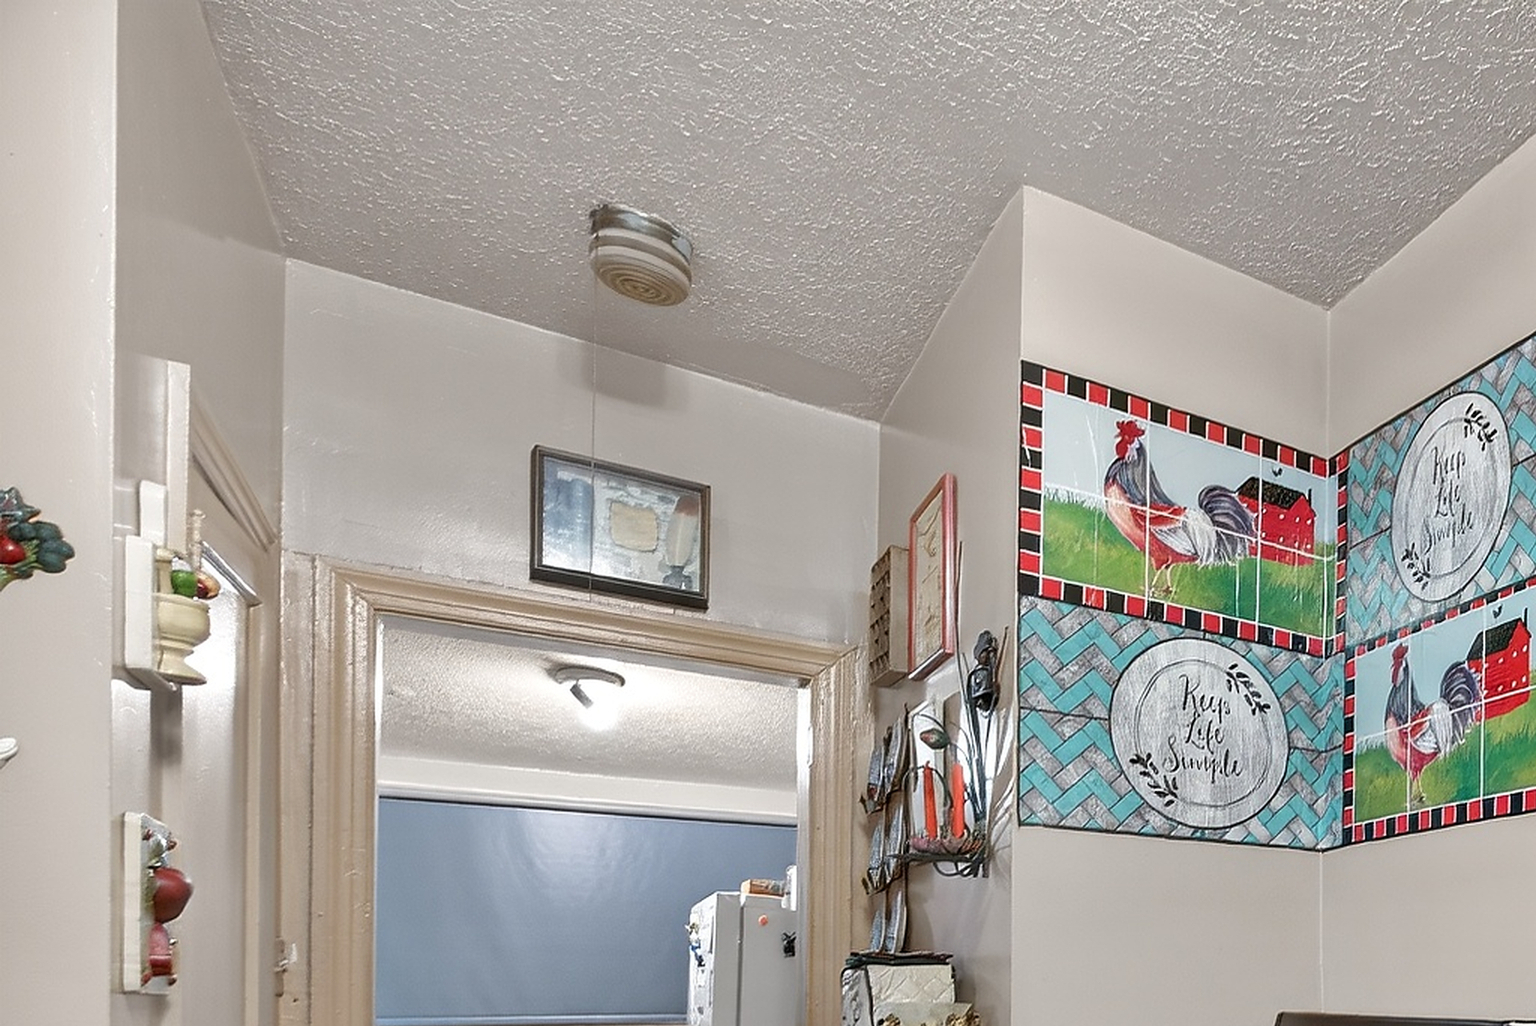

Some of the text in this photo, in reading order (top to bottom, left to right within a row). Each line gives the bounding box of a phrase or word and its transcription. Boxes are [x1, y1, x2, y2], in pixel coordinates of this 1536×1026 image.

[1431, 445, 1466, 485] Keep
[1434, 479, 1461, 518] Life
[1421, 502, 1474, 556] Simple
[1178, 674, 1231, 724] Keep
[1183, 712, 1225, 755] Life
[1162, 735, 1243, 784] Simple
